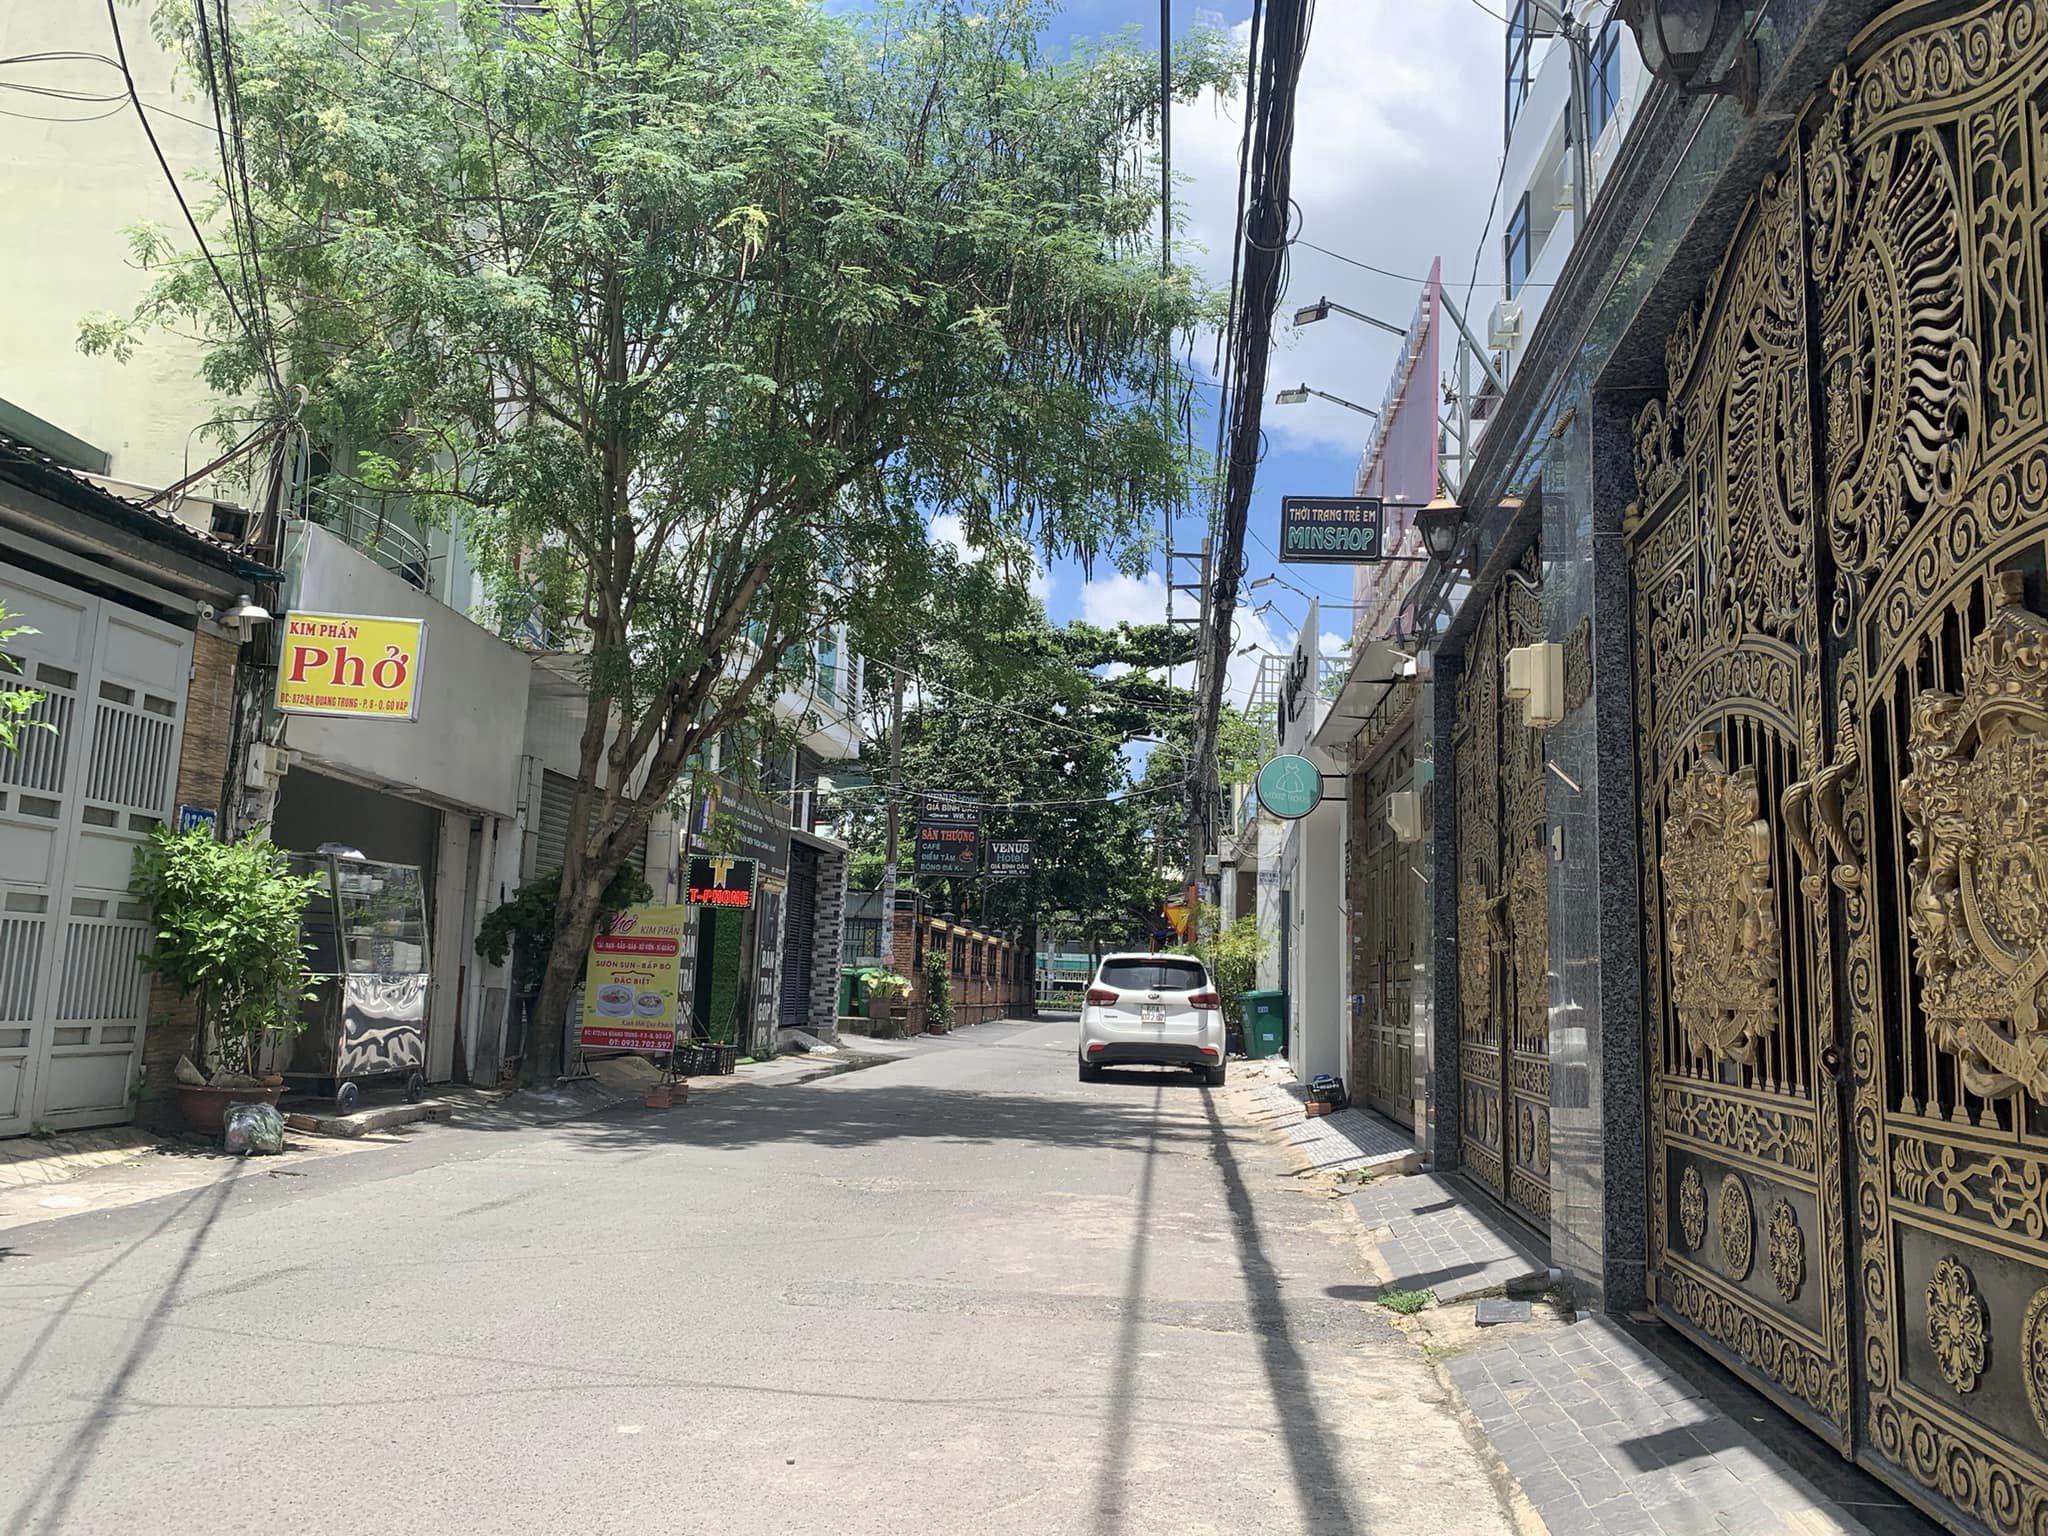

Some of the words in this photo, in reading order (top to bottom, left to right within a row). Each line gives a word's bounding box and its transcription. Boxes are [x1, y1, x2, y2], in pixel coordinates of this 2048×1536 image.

[1312, 508, 1342, 522] TRANG
[1362, 510, 1376, 522] EM
[1288, 526, 1375, 551] MINSHOP
[289, 621, 316, 636] KIM
[319, 620, 358, 639] PHẤN
[288, 645, 409, 689] Phở
[921, 827, 939, 840] SÂN
[940, 828, 975, 843] THƯỢNG
[991, 842, 1030, 854] VENUS
[996, 853, 1024, 863] Hotel
[690, 888, 749, 905] T-PHONE
[640, 926, 656, 935] KIM
